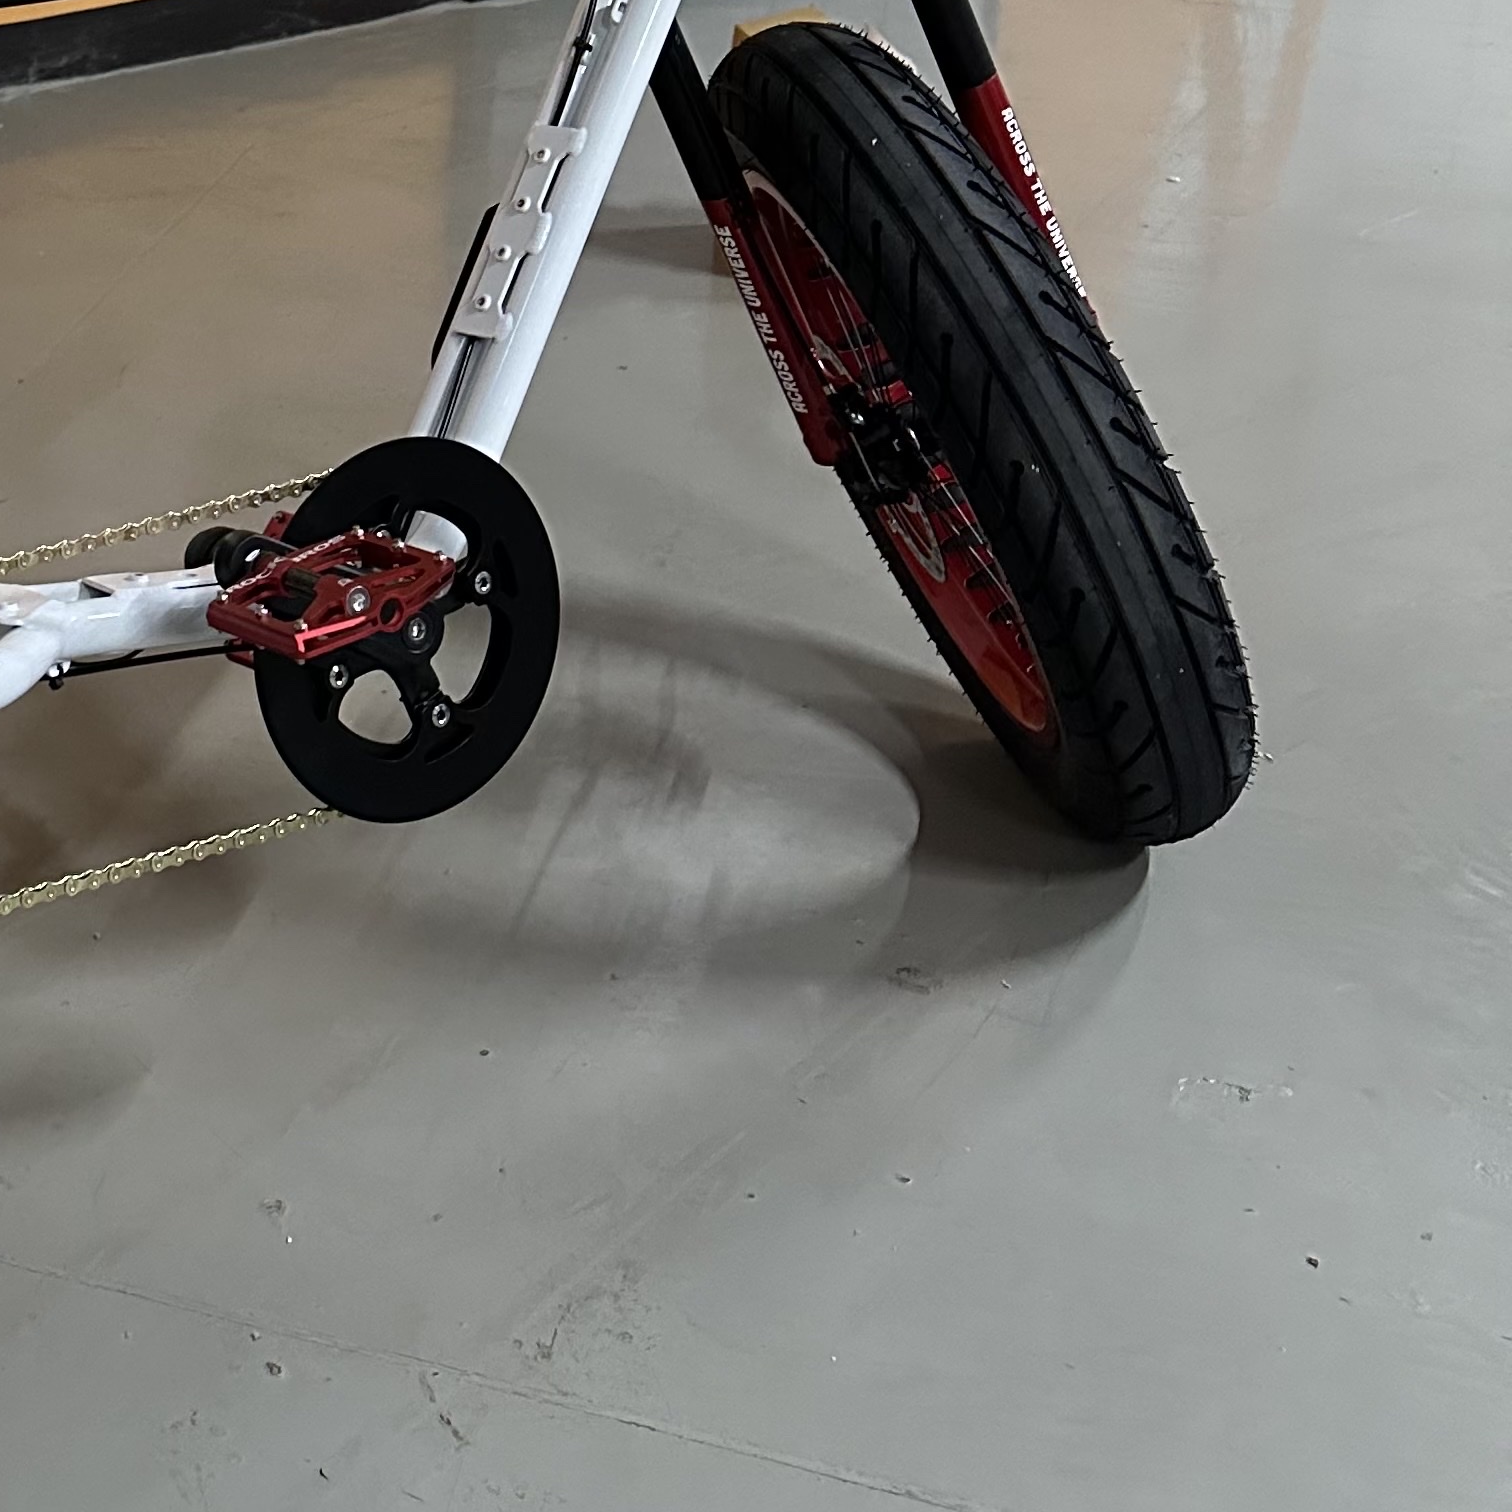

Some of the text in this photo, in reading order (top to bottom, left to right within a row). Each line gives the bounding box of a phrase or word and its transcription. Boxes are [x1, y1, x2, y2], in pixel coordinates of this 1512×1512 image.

[1001, 106, 1036, 177] ACROSS
[1030, 177, 1053, 216] THE
[714, 224, 808, 414] ACROSS THE UNIVERSE
